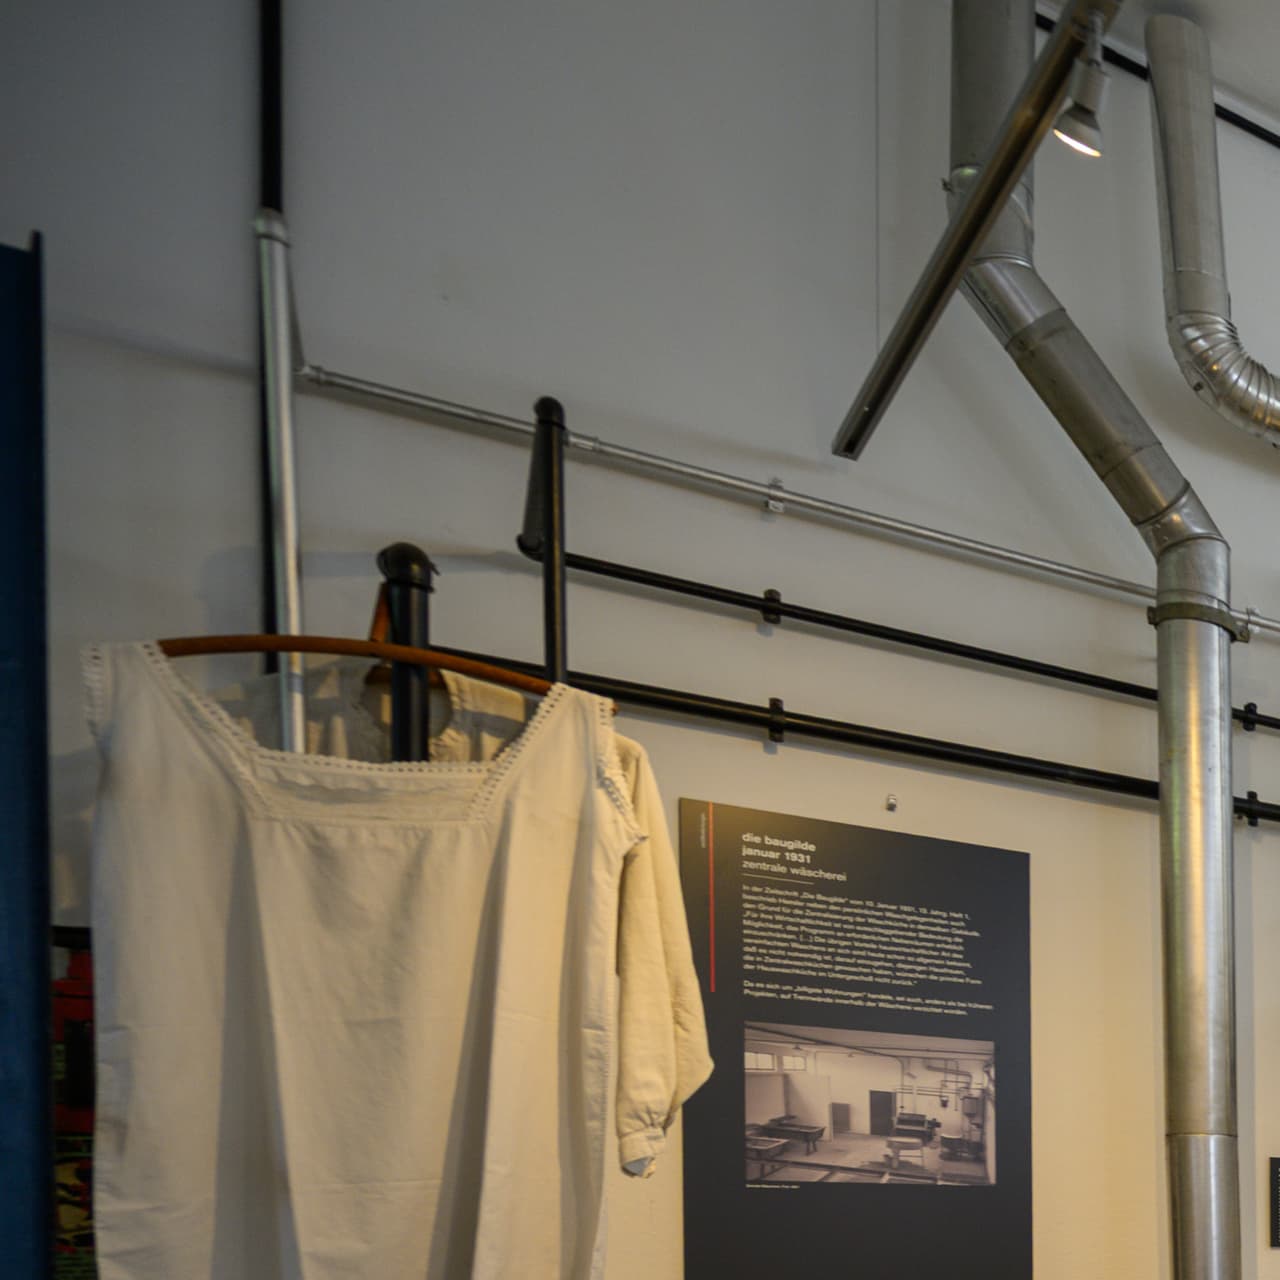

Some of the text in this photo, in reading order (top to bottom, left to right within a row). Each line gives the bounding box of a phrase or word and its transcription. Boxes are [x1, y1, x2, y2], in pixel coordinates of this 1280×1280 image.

[742, 832, 816, 852] die baugilde
[742, 845, 811, 863] januar 1931
[742, 860, 847, 881] zentrale wäscherei
